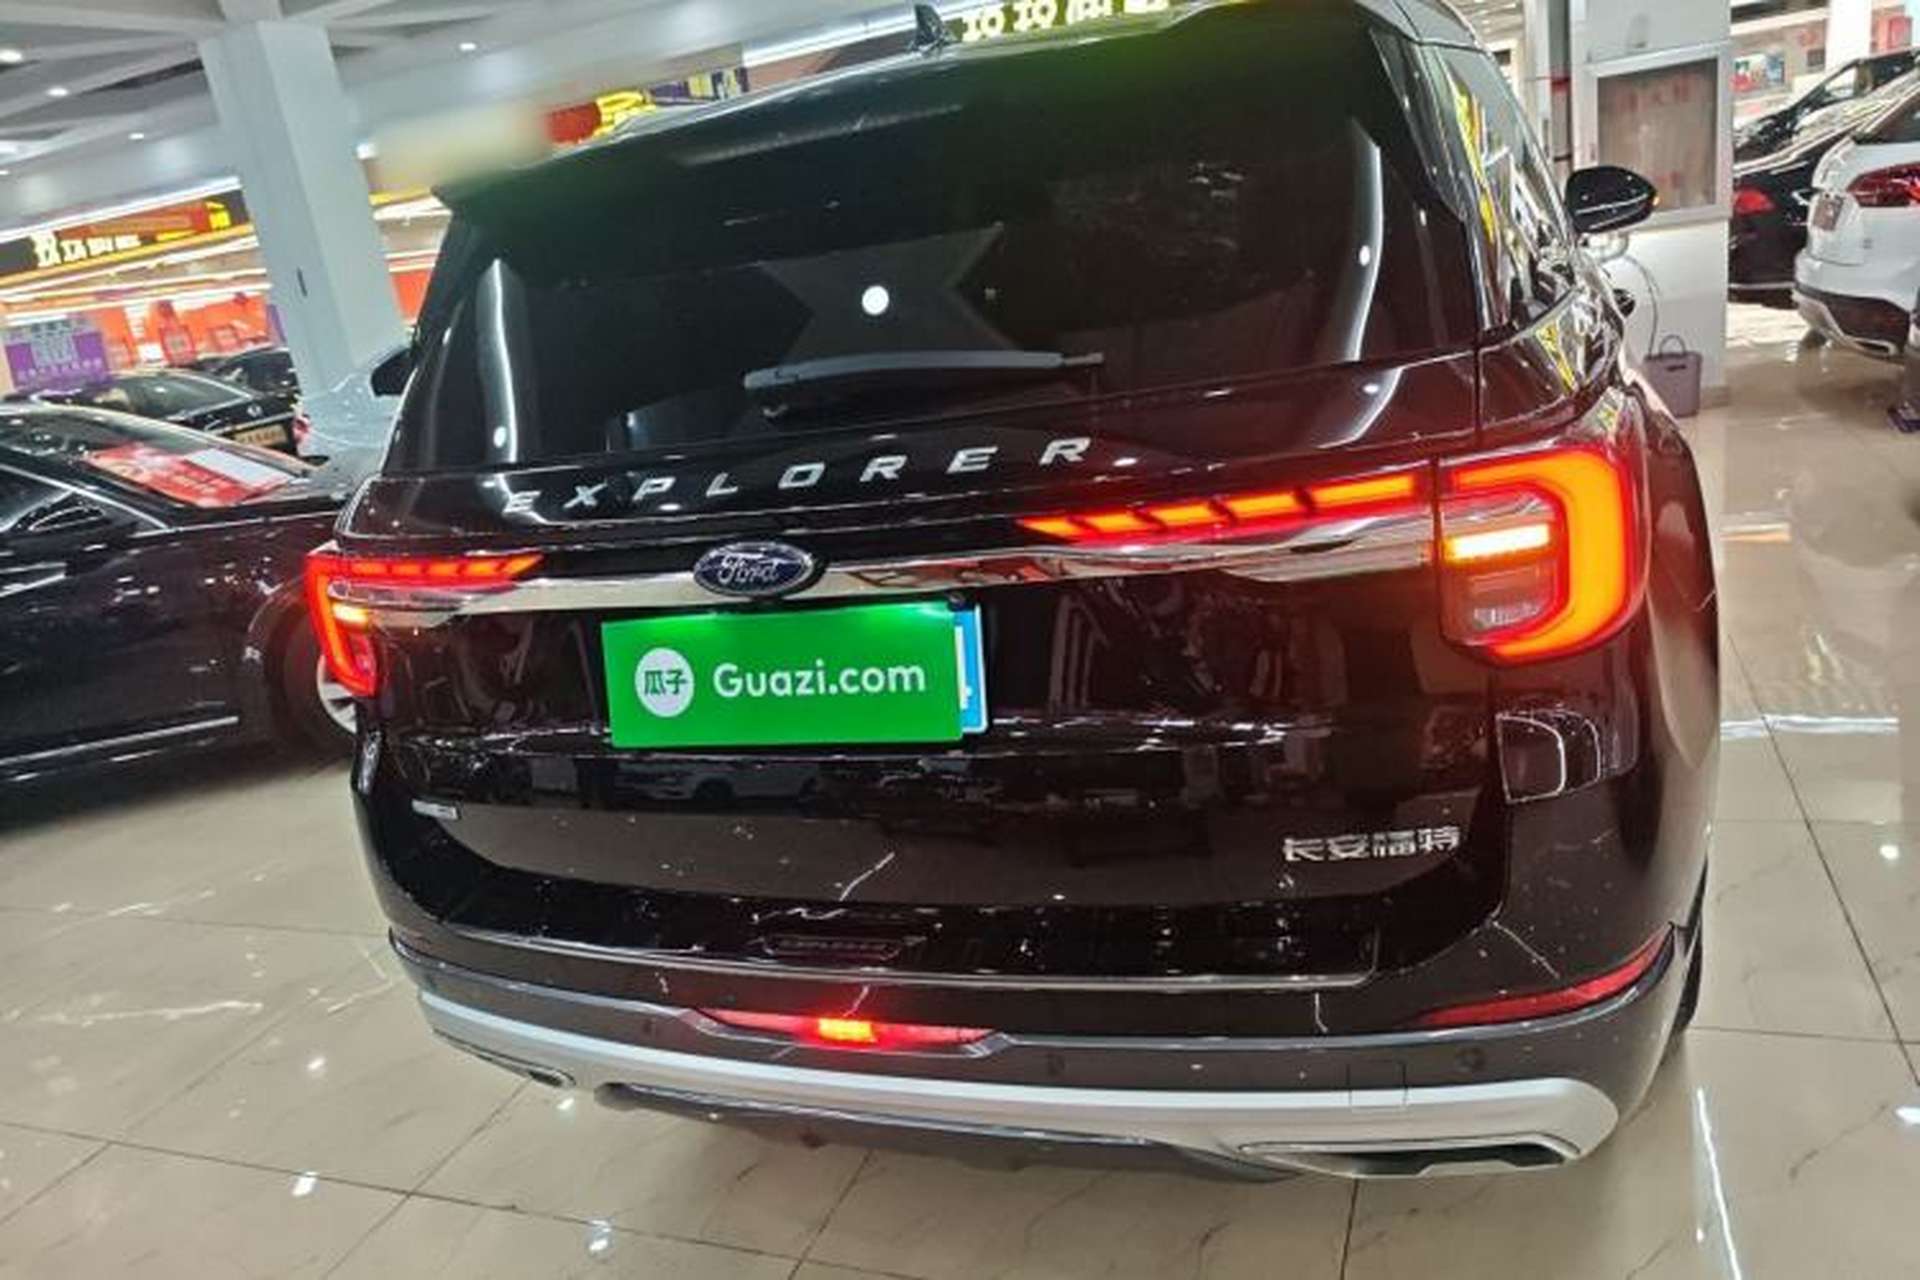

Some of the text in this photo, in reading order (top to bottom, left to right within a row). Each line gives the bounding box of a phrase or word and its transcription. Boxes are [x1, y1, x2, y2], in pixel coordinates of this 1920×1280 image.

[503, 437, 1092, 514] EXPLORER
[716, 551, 782, 585] Ford
[1282, 825, 1461, 862] 长安福特
